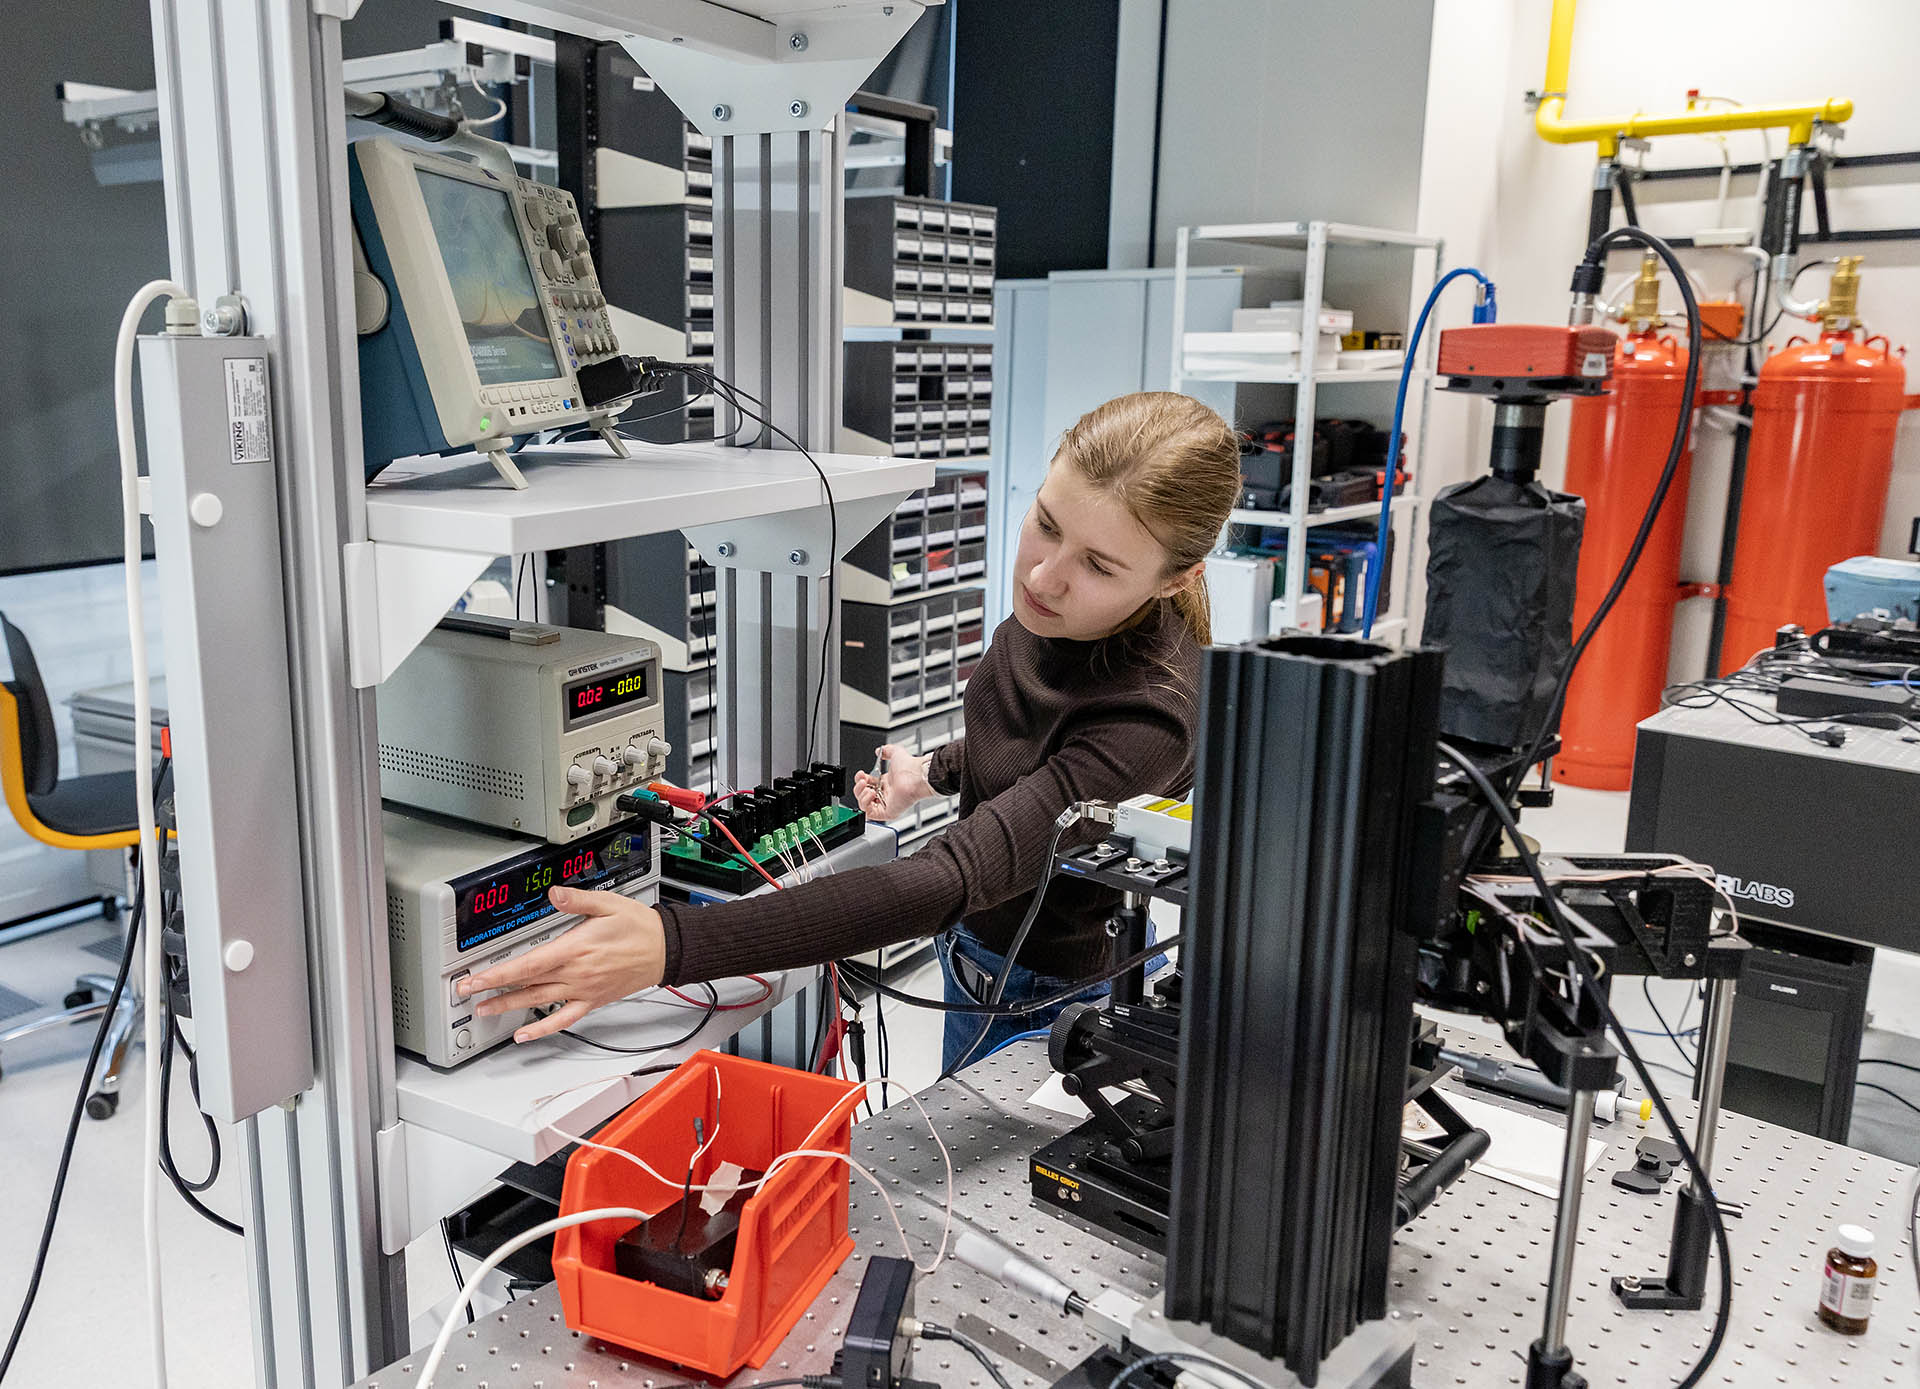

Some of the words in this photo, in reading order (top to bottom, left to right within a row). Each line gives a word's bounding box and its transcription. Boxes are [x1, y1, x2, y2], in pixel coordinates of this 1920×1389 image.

[234, 421, 245, 461] VIKING
[577, 686, 603, 708] 0.02
[575, 746, 599, 758] CURRENT
[562, 850, 594, 879] 0.00
[525, 867, 552, 892] 15.0
[473, 884, 509, 914] 0.00
[460, 924, 505, 949] LABORATORY
[506, 921, 516, 931] DC
[516, 910, 540, 926] POWER
[529, 934, 551, 947] VOLTAGE
[489, 951, 513, 965] CURRENT
